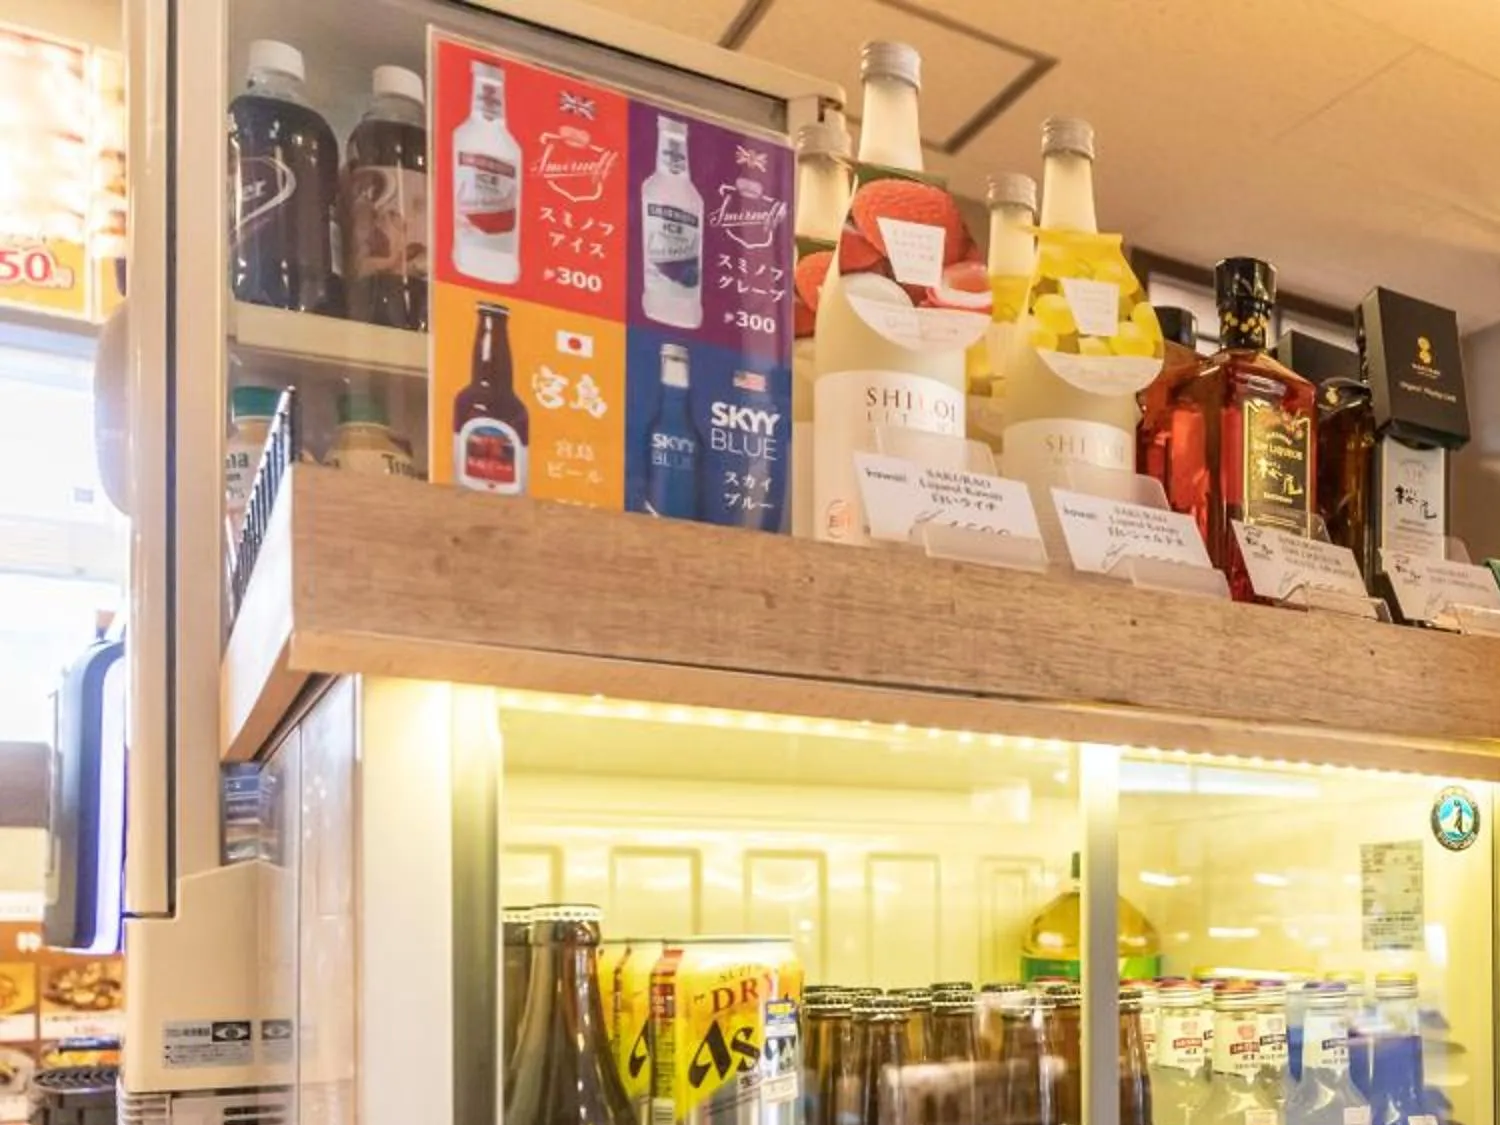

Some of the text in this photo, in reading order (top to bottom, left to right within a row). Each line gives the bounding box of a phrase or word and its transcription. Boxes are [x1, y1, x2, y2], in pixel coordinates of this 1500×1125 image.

[549, 231, 605, 258] アイス
[718, 254, 784, 281] スミノフ
[711, 401, 781, 436] SKYY
[711, 427, 777, 461] BLUE
[724, 471, 772, 493] スカイ
[711, 972, 775, 1014] DRY
